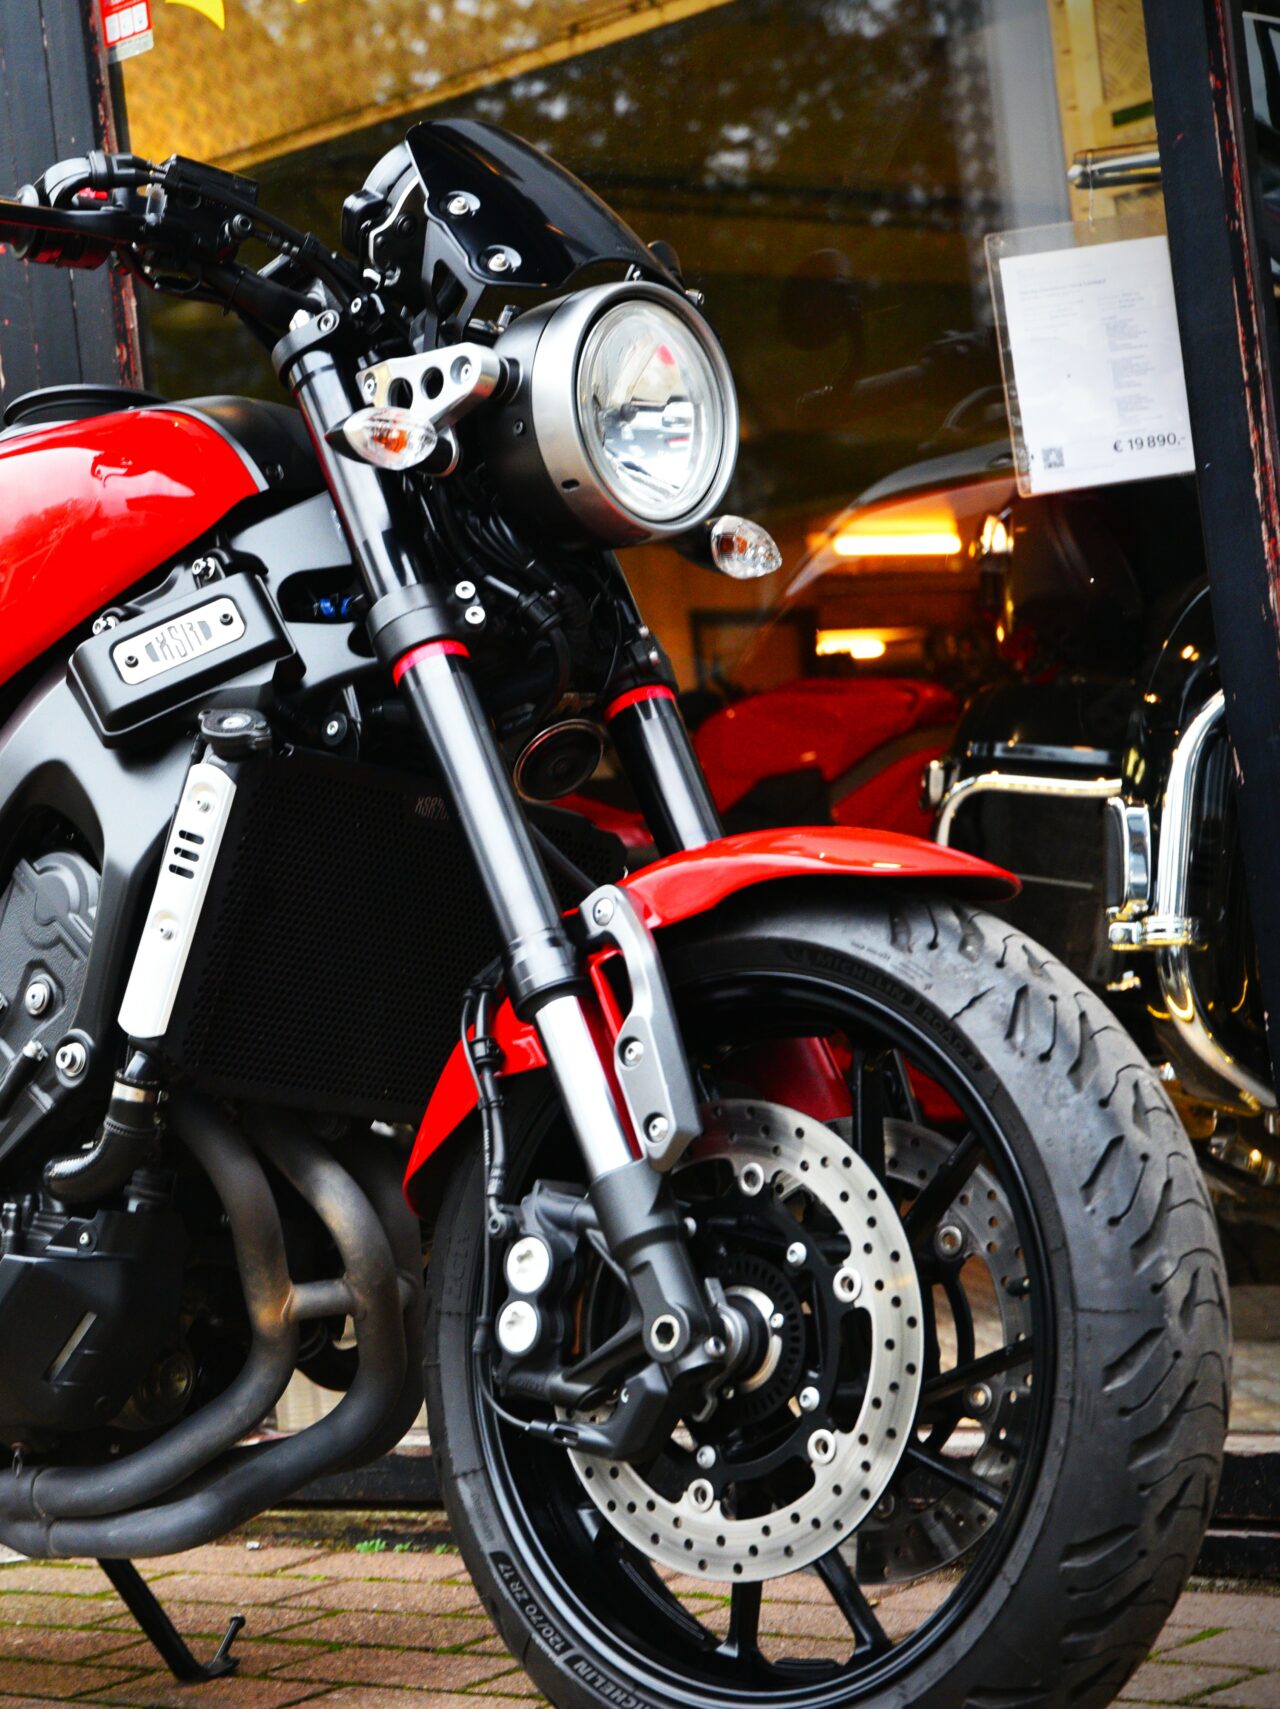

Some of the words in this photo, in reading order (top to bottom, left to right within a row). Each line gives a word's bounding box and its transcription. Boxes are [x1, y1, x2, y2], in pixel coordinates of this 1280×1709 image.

[497, 1561, 517, 1581] 17
[509, 1579, 529, 1601] ZR
[524, 1603, 566, 1652] 120/70
[573, 1659, 657, 1709] ICHELIN
